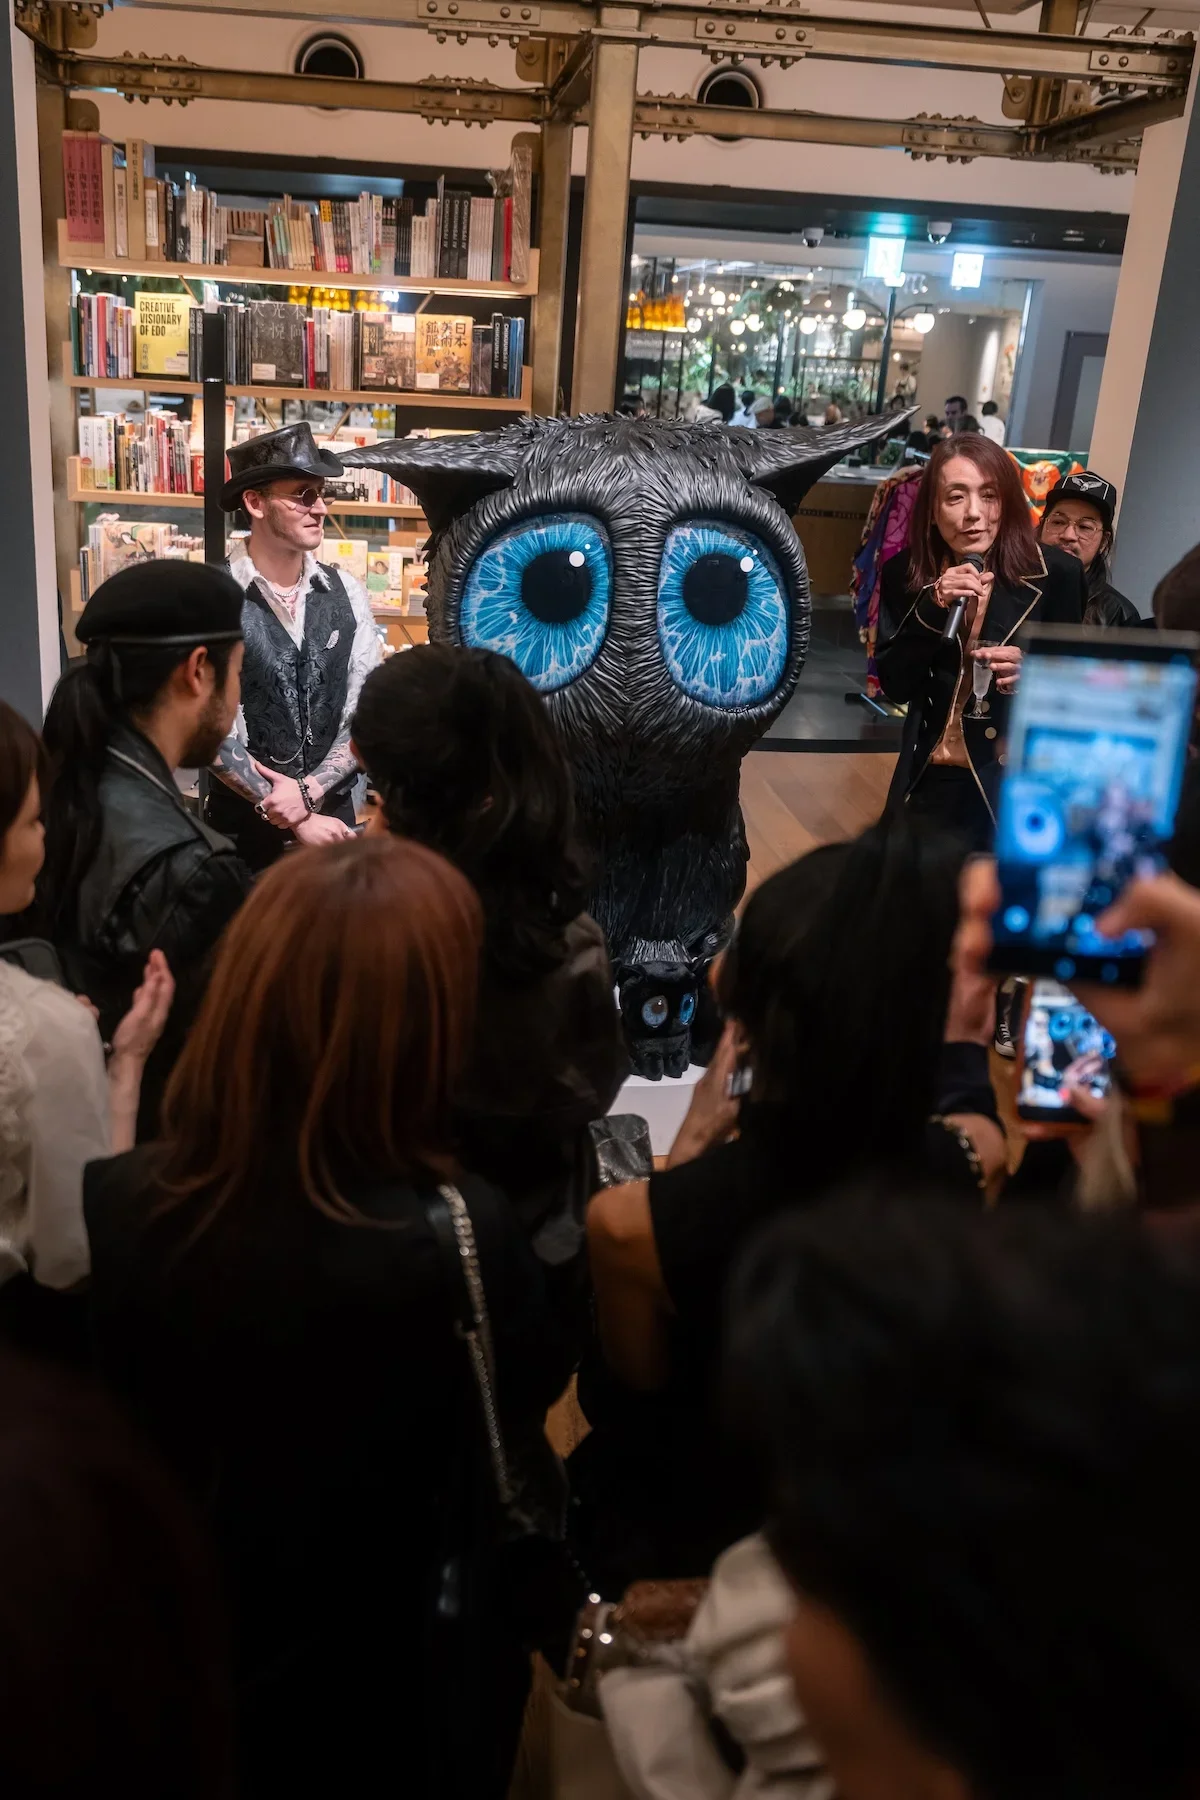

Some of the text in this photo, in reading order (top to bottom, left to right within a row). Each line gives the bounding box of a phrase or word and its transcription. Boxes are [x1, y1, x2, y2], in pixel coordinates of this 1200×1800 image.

[139, 301, 176, 313] CREATIVE
[139, 313, 182, 326] VISIONARY
[139, 325, 166, 337] OF EDO
[454, 322, 467, 348] 日本
